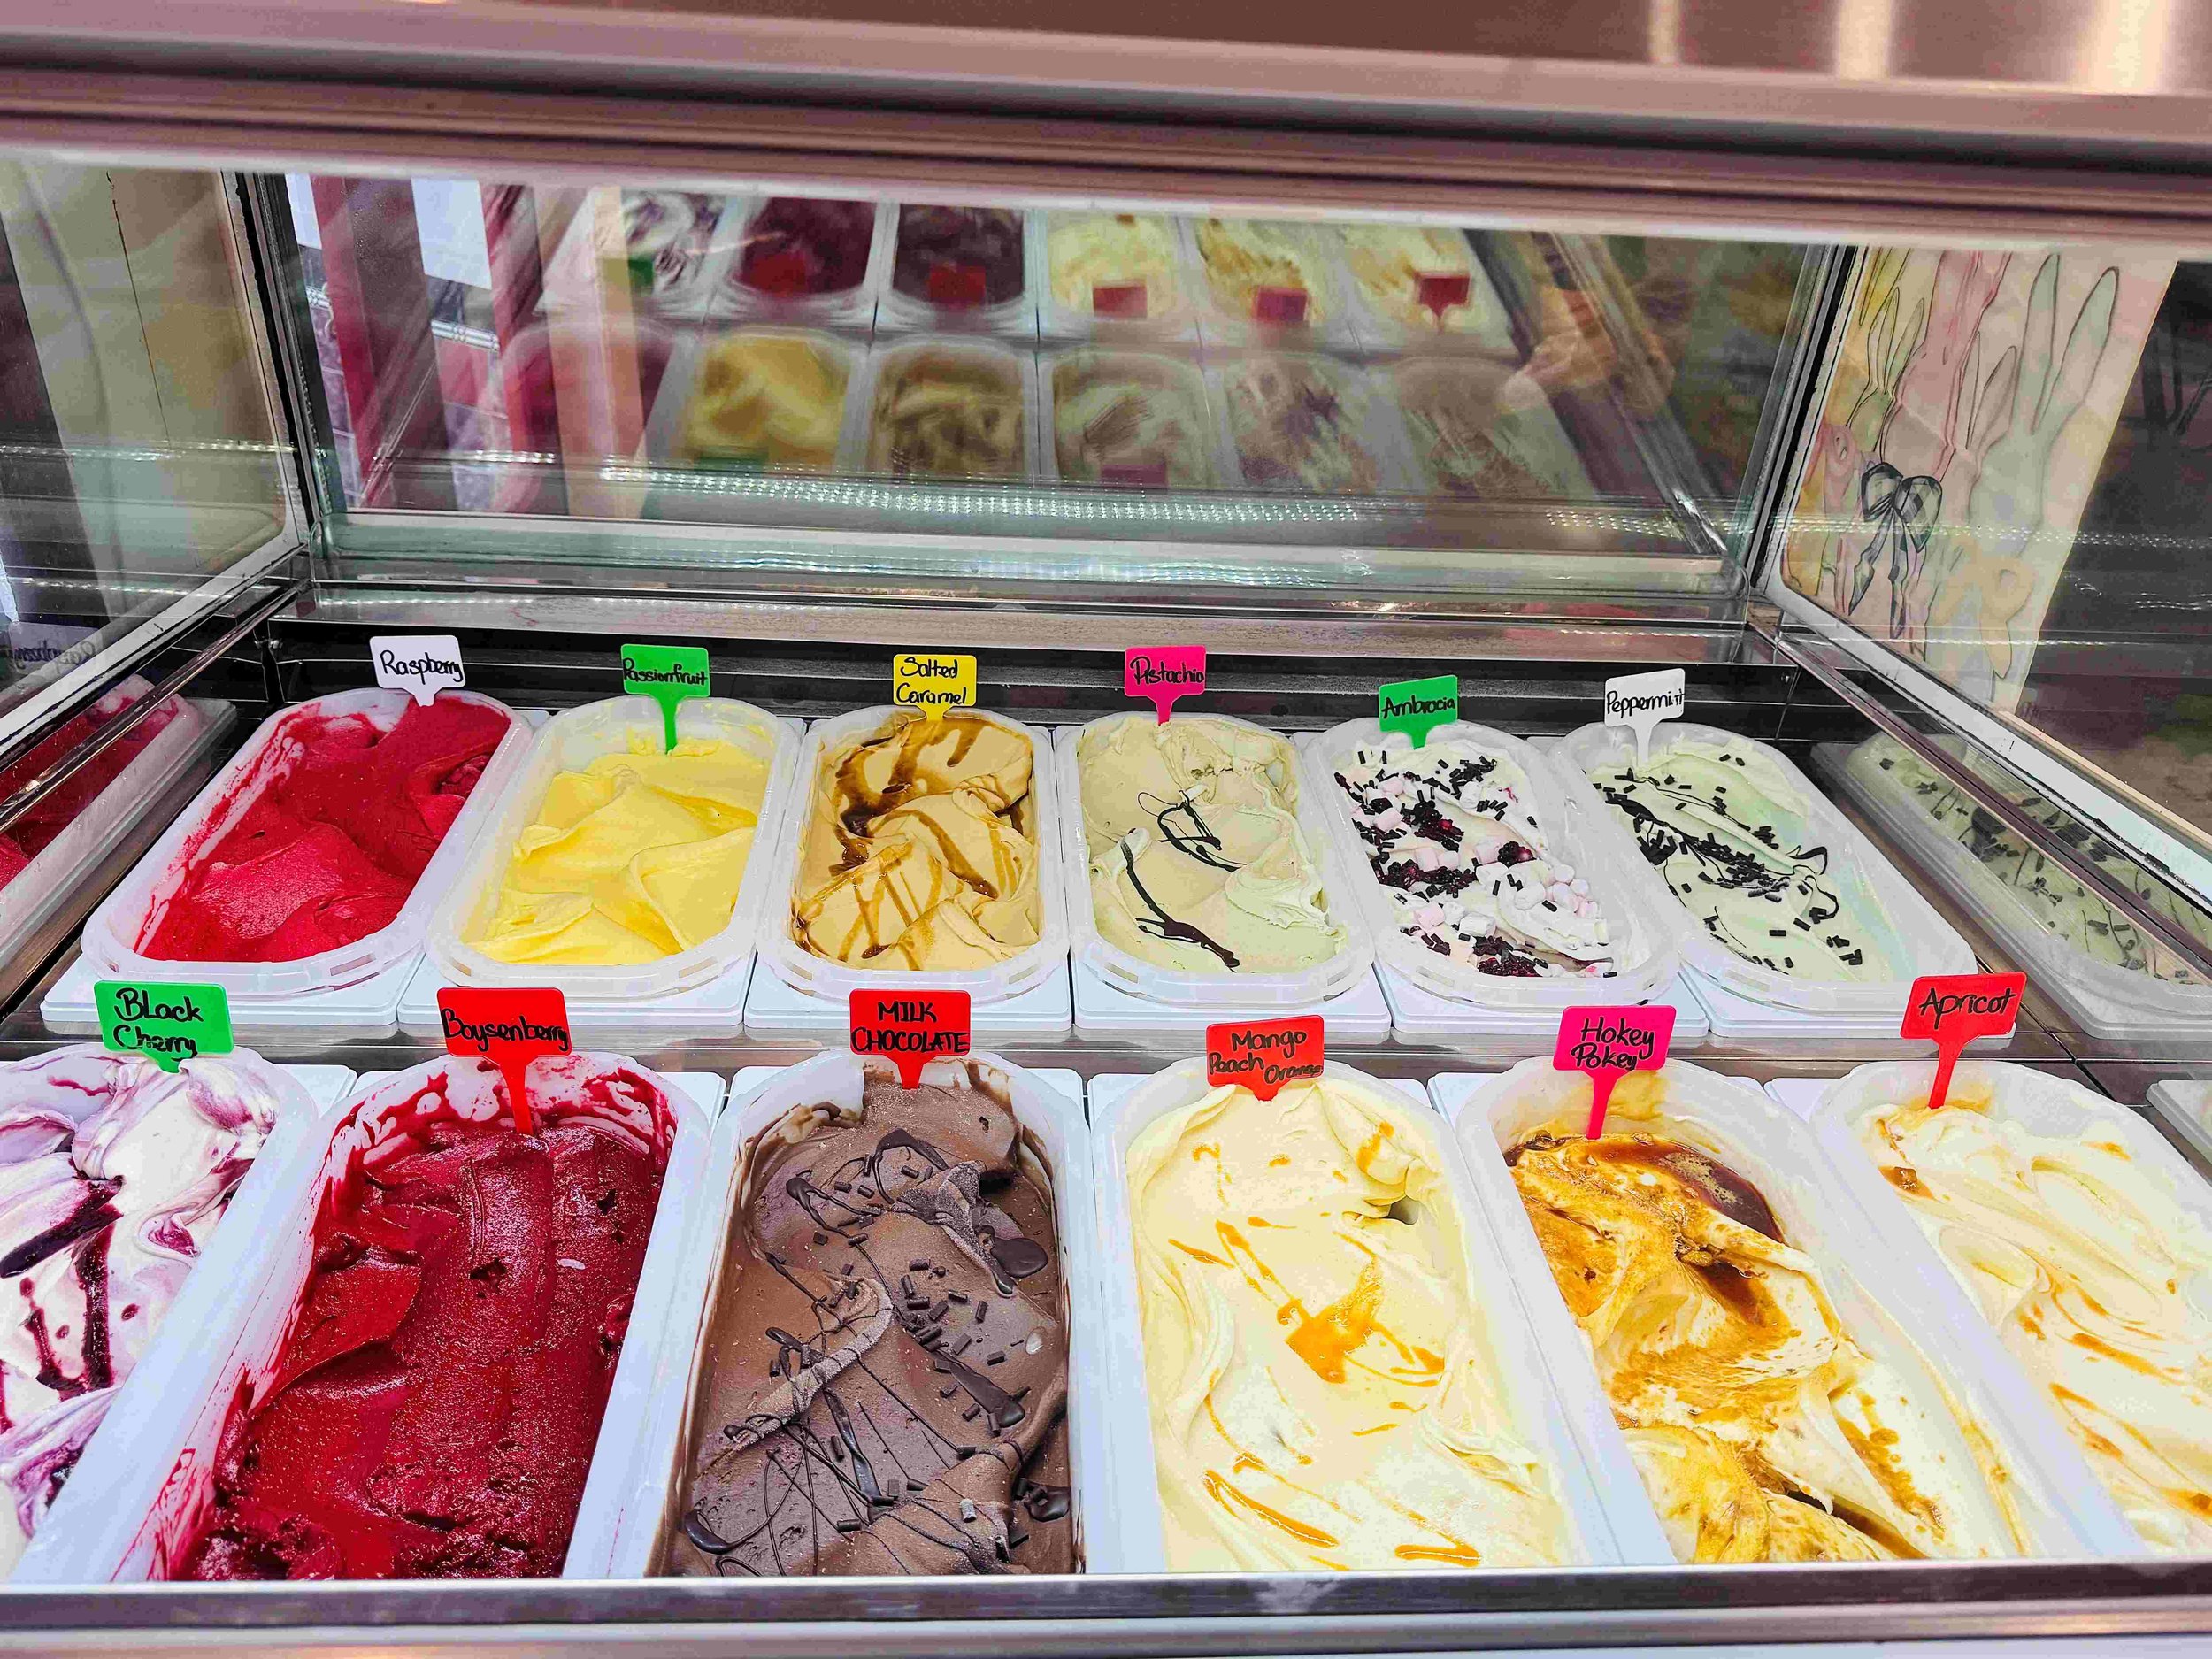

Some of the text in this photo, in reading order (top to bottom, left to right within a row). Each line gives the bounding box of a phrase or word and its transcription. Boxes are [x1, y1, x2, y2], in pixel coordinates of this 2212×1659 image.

[380, 649, 464, 685] Raspberry
[622, 657, 708, 685] Passionfruit
[900, 657, 958, 679] Salted
[1129, 656, 1204, 685] Pistachio
[896, 682, 966, 705] Caramel
[878, 1001, 937, 1022] MILK
[1918, 987, 2016, 1029] Apricot
[113, 1025, 198, 1061] Cherry
[441, 1008, 569, 1052] Boysenberry
[851, 1026, 970, 1053] CHOCOLATE
[1231, 1030, 1307, 1058] Mango
[1580, 1017, 1655, 1059] Hokey
[1571, 1042, 1638, 1071] Pokey
